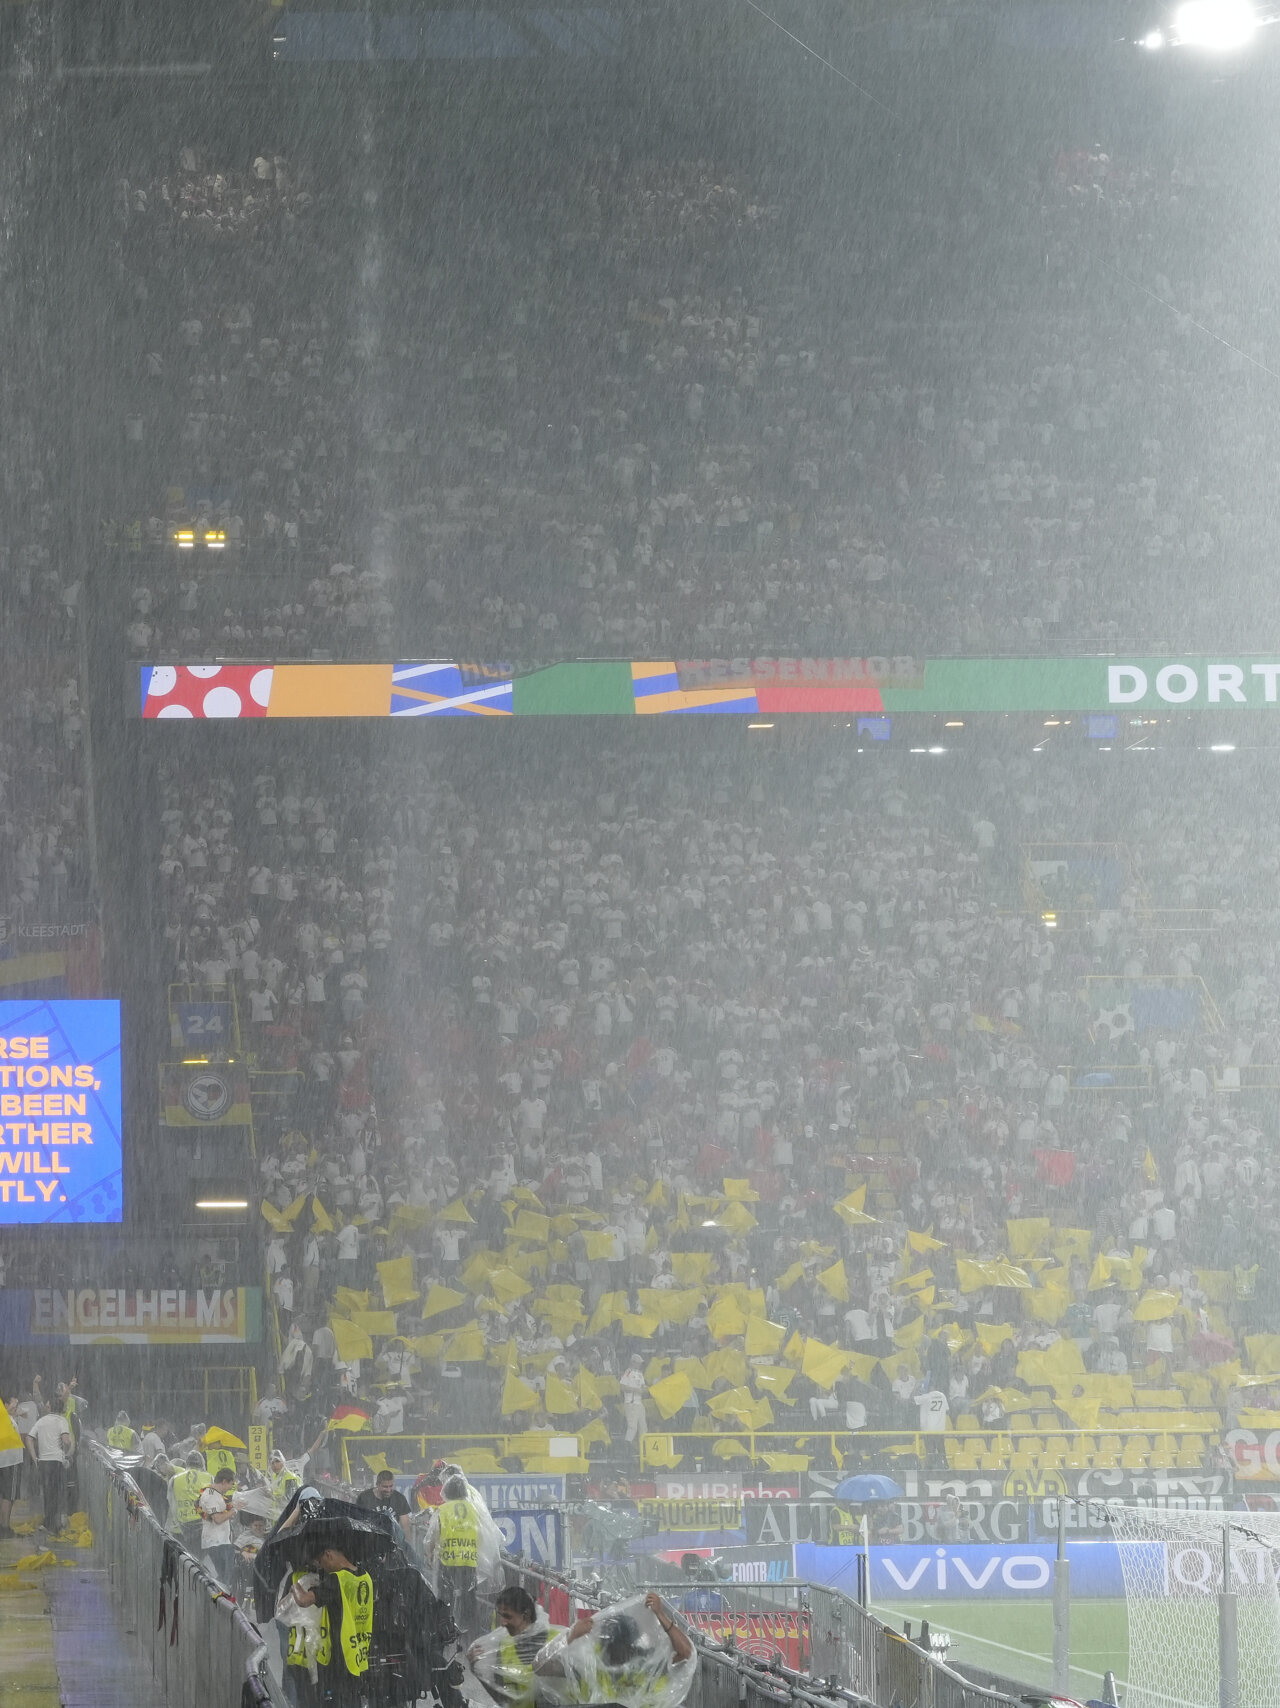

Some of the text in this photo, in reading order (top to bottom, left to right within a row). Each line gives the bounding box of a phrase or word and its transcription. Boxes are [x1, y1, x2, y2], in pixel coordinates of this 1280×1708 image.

[1108, 664, 1280, 703] DORT
[18, 923, 86, 937] KLEESTADT
[187, 1015, 223, 1034] 24
[1, 1094, 86, 1116] BEEN
[34, 1288, 234, 1328] ENGELHELMS
[930, 1400, 943, 1411] 27
[881, 1548, 1050, 1590] vivo
[1173, 1548, 1280, 1593] QAT
